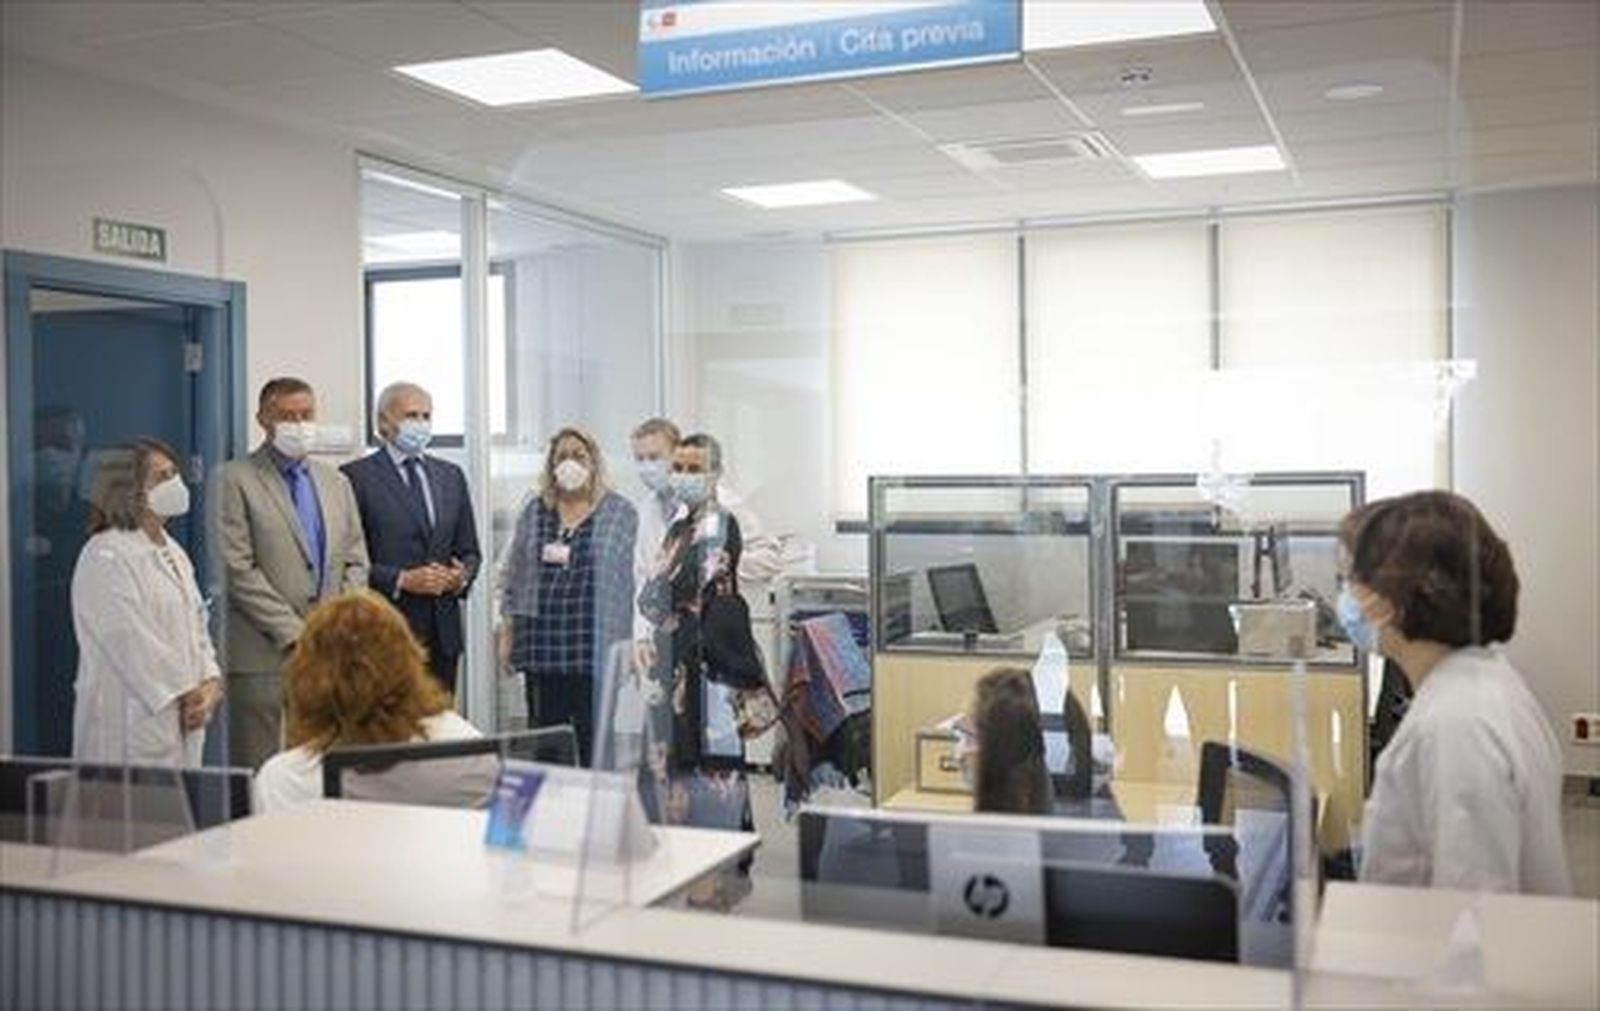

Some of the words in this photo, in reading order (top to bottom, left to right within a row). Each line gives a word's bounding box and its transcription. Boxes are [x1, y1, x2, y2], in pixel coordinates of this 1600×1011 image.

[667, 38, 816, 75] Información
[840, 24, 894, 55] Cita
[902, 19, 985, 51] previa
[98, 222, 162, 257] SALIDA
